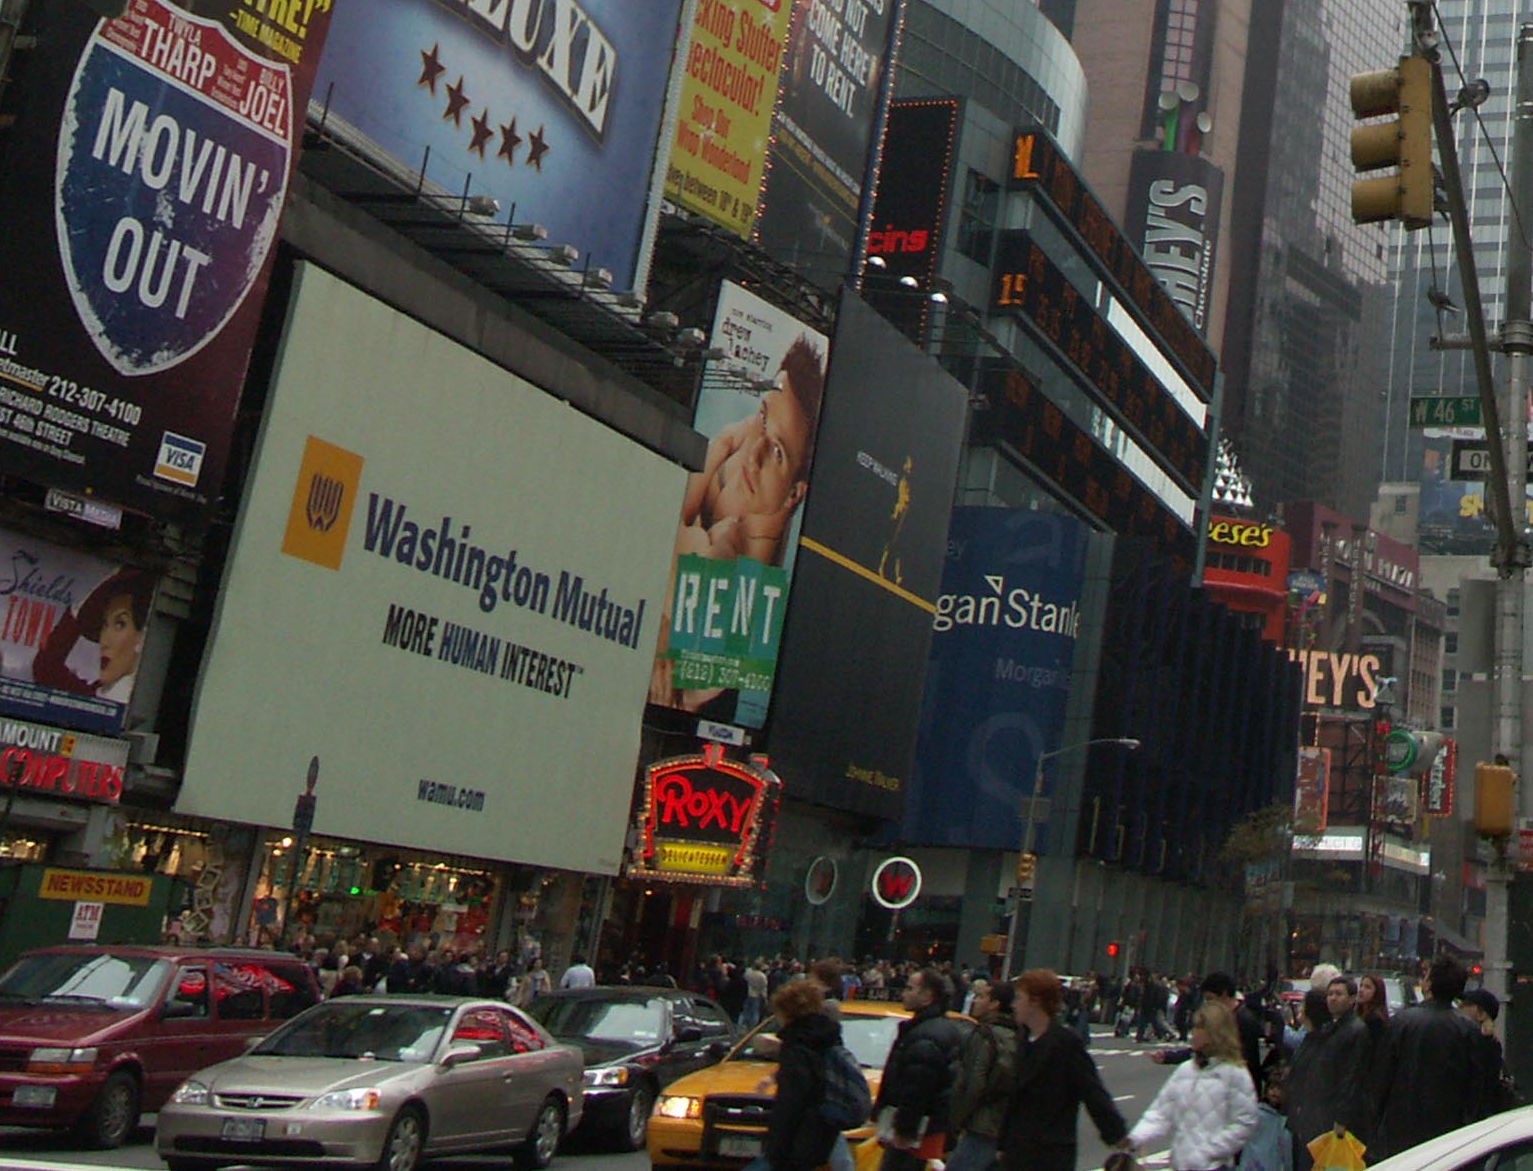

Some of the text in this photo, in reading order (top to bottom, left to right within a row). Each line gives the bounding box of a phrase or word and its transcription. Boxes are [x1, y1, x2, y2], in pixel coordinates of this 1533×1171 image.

[141, 18, 215, 90] THARP
[840, 31, 870, 85] HERE
[239, 82, 287, 136] JOEL
[103, 216, 210, 320] OUT
[49, 376, 142, 426] 212-307-4100
[1415, 397, 1476, 424] W 46 ST
[167, 446, 196, 471] VISA
[363, 493, 646, 651] Washington Mutual
[5, 591, 58, 648] TOWN
[674, 570, 782, 646] RENT
[417, 778, 486, 813] wamu.com
[656, 774, 753, 830] ROXY
[46, 872, 147, 900] NEWSSTAND
